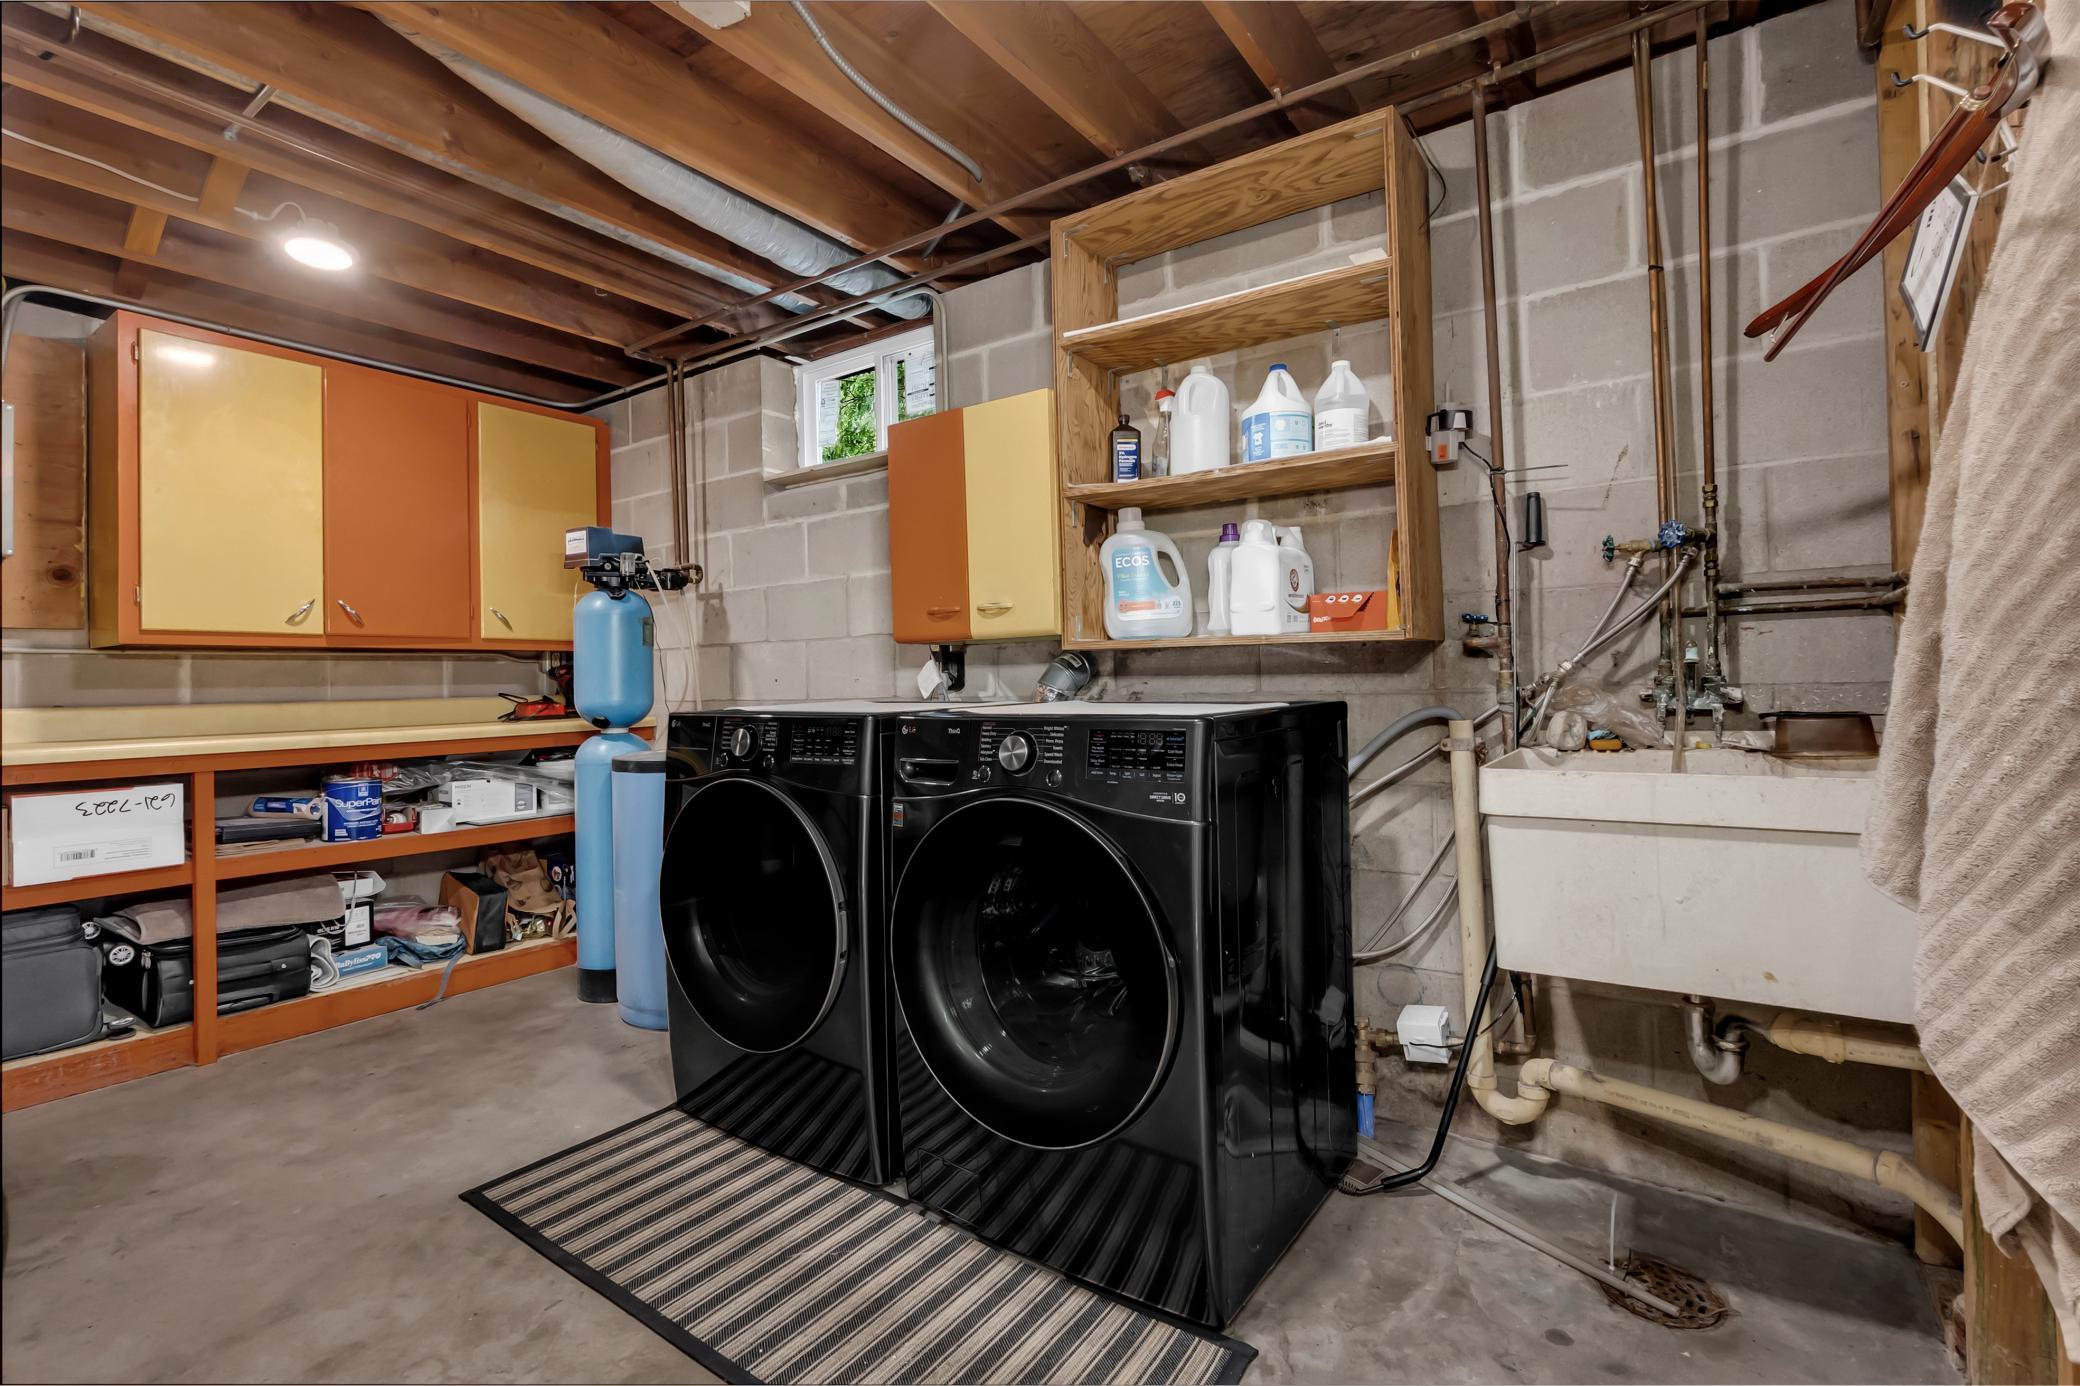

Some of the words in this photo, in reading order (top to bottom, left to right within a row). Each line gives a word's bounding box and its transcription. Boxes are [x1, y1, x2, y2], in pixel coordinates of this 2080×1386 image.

[1115, 555, 1150, 568] ECOS
[75, 793, 175, 816] 621-7223
[335, 797, 382, 809] SuperPain
